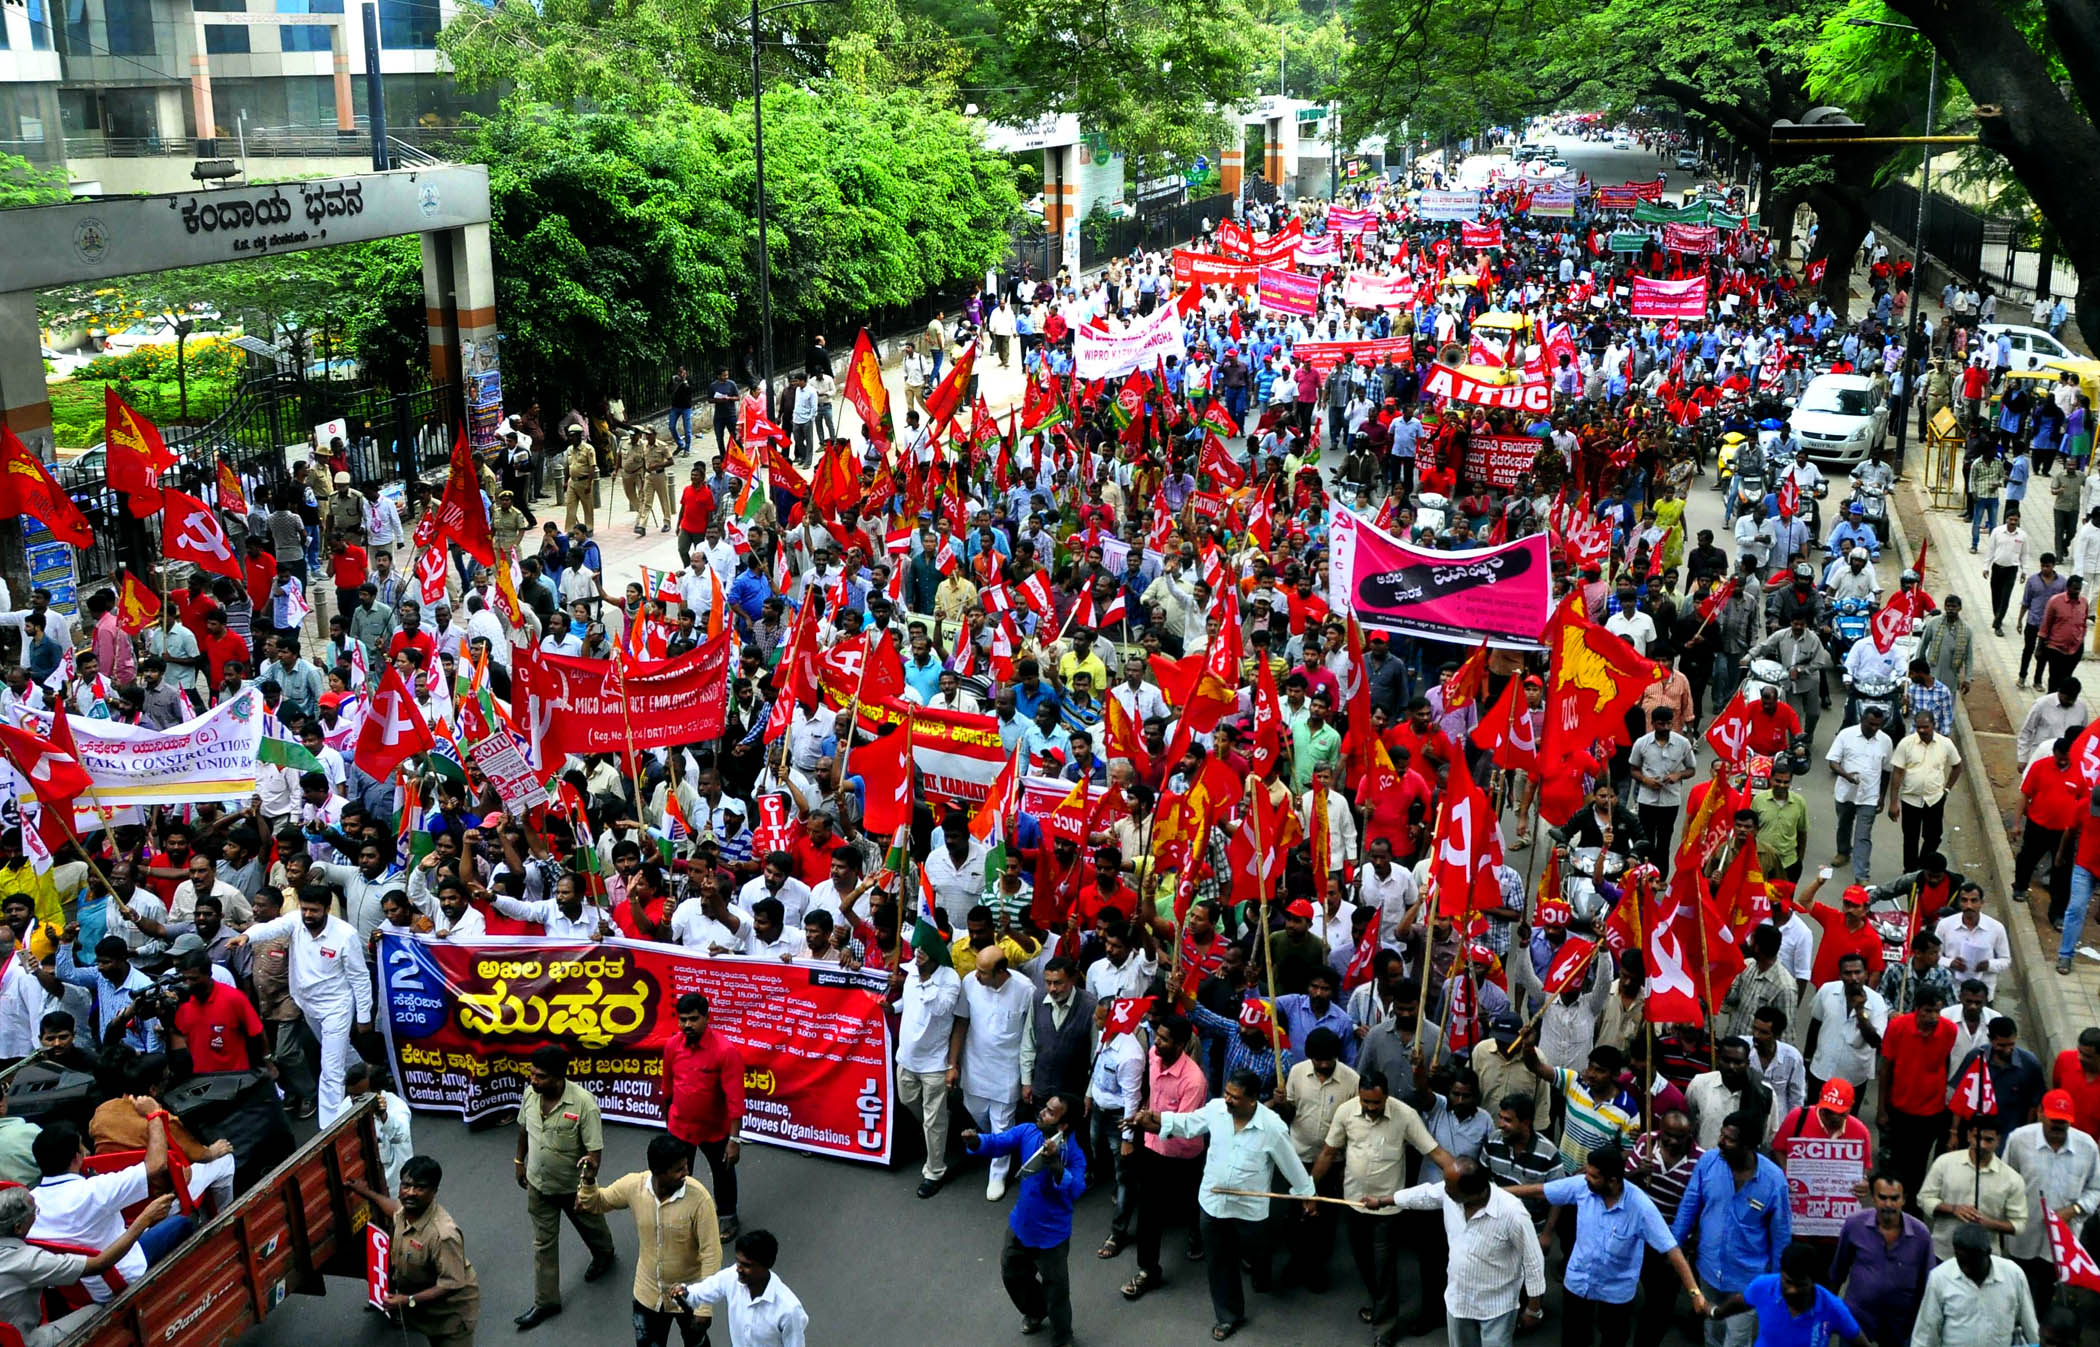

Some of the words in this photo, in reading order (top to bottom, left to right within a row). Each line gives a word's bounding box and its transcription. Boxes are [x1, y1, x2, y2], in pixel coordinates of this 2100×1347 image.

[182, 189, 291, 234] ಕಂದಾಯ
[305, 181, 364, 226] ಭವನ
[1426, 370, 1549, 410] AITUC
[1394, 585, 1424, 602] ಭಾರತ
[574, 697, 600, 715] MICO
[480, 732, 511, 760] CITU
[195, 755, 238, 772] UNION
[389, 949, 424, 991] 2
[477, 959, 543, 979] ಅಖಿಲ
[548, 955, 625, 983] ಭಾರತ
[393, 993, 442, 1015] ಸೆಪ್ಟೆಂಬರ್
[396, 1012, 426, 1024] 2016
[458, 979, 650, 1049] ಮುಷ್ಕರ
[400, 1043, 446, 1074] ಕೇಂದ್ರ
[405, 1071, 435, 1084] INTUC
[491, 1076, 517, 1090] CITU
[612, 1080, 653, 1097] AICCTU
[409, 1086, 444, 1102] Central
[470, 1090, 525, 1113] Governme
[626, 1099, 663, 1118] Sector,
[743, 1098, 792, 1119] nsurance,
[856, 1077, 884, 1150] JCTU
[1823, 1095, 1844, 1106] CITU
[741, 1115, 779, 1134] ployees
[780, 1121, 851, 1147] Organisations
[1806, 1142, 1863, 1160] CITU
[1790, 1180, 1800, 1192] 2
[372, 1231, 389, 1306] CITU
